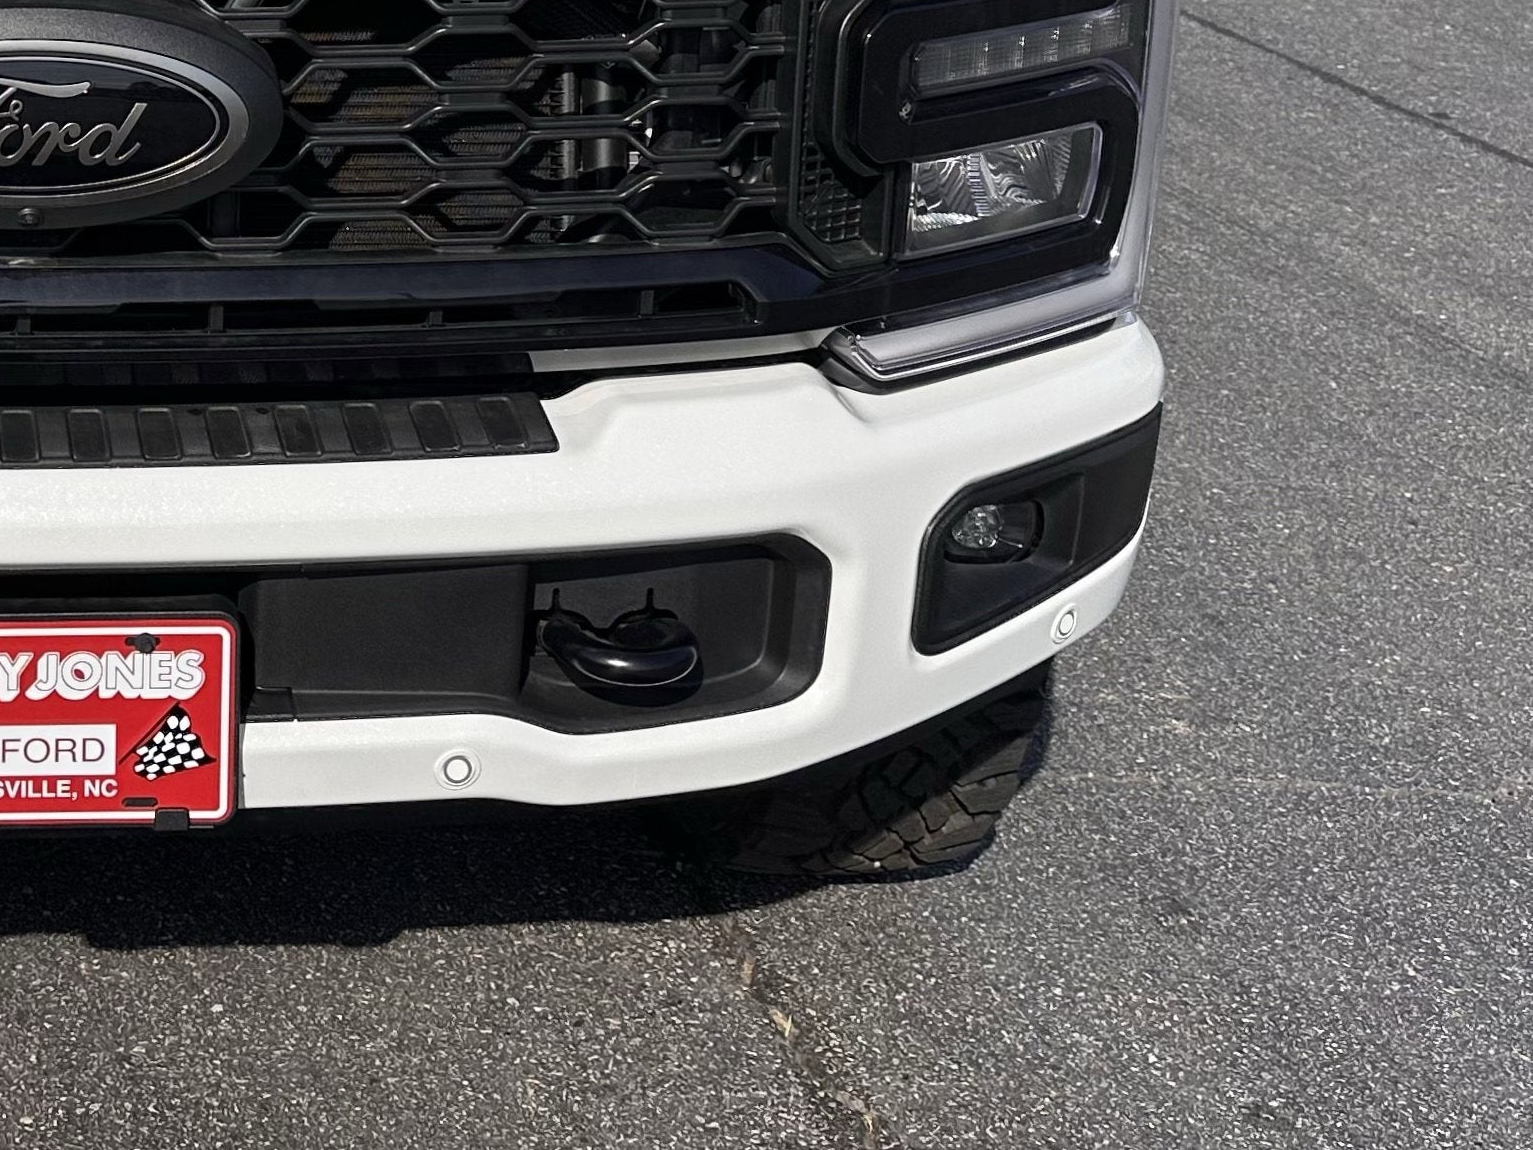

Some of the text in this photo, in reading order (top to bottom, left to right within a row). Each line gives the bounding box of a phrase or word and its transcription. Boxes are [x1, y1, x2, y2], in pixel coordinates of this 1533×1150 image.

[25, 650, 206, 700] JONES
[1, 738, 106, 764] FORD
[84, 779, 118, 798] NC
